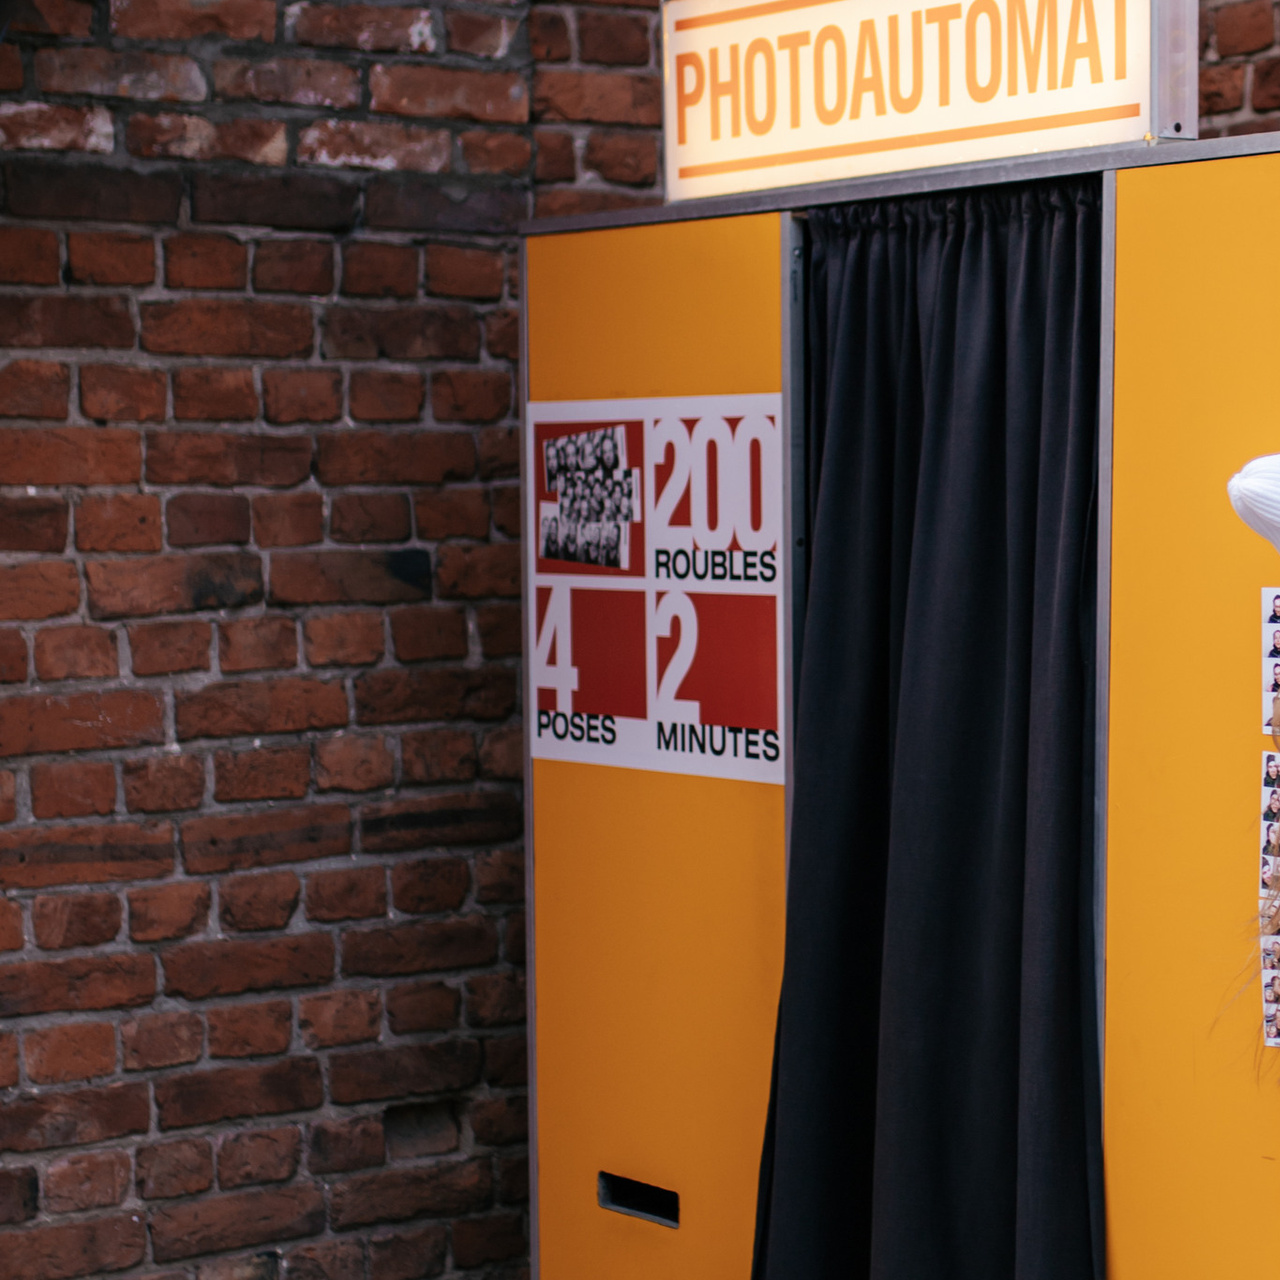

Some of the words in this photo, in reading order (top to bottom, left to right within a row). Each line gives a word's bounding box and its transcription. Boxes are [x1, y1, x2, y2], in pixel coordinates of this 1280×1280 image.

[652, 414, 776, 553] 200
[655, 548, 777, 583] ROUBLES
[535, 585, 579, 714] 4
[654, 590, 701, 726] 2
[537, 709, 617, 746] POSES
[656, 720, 780, 763] MINUTES
